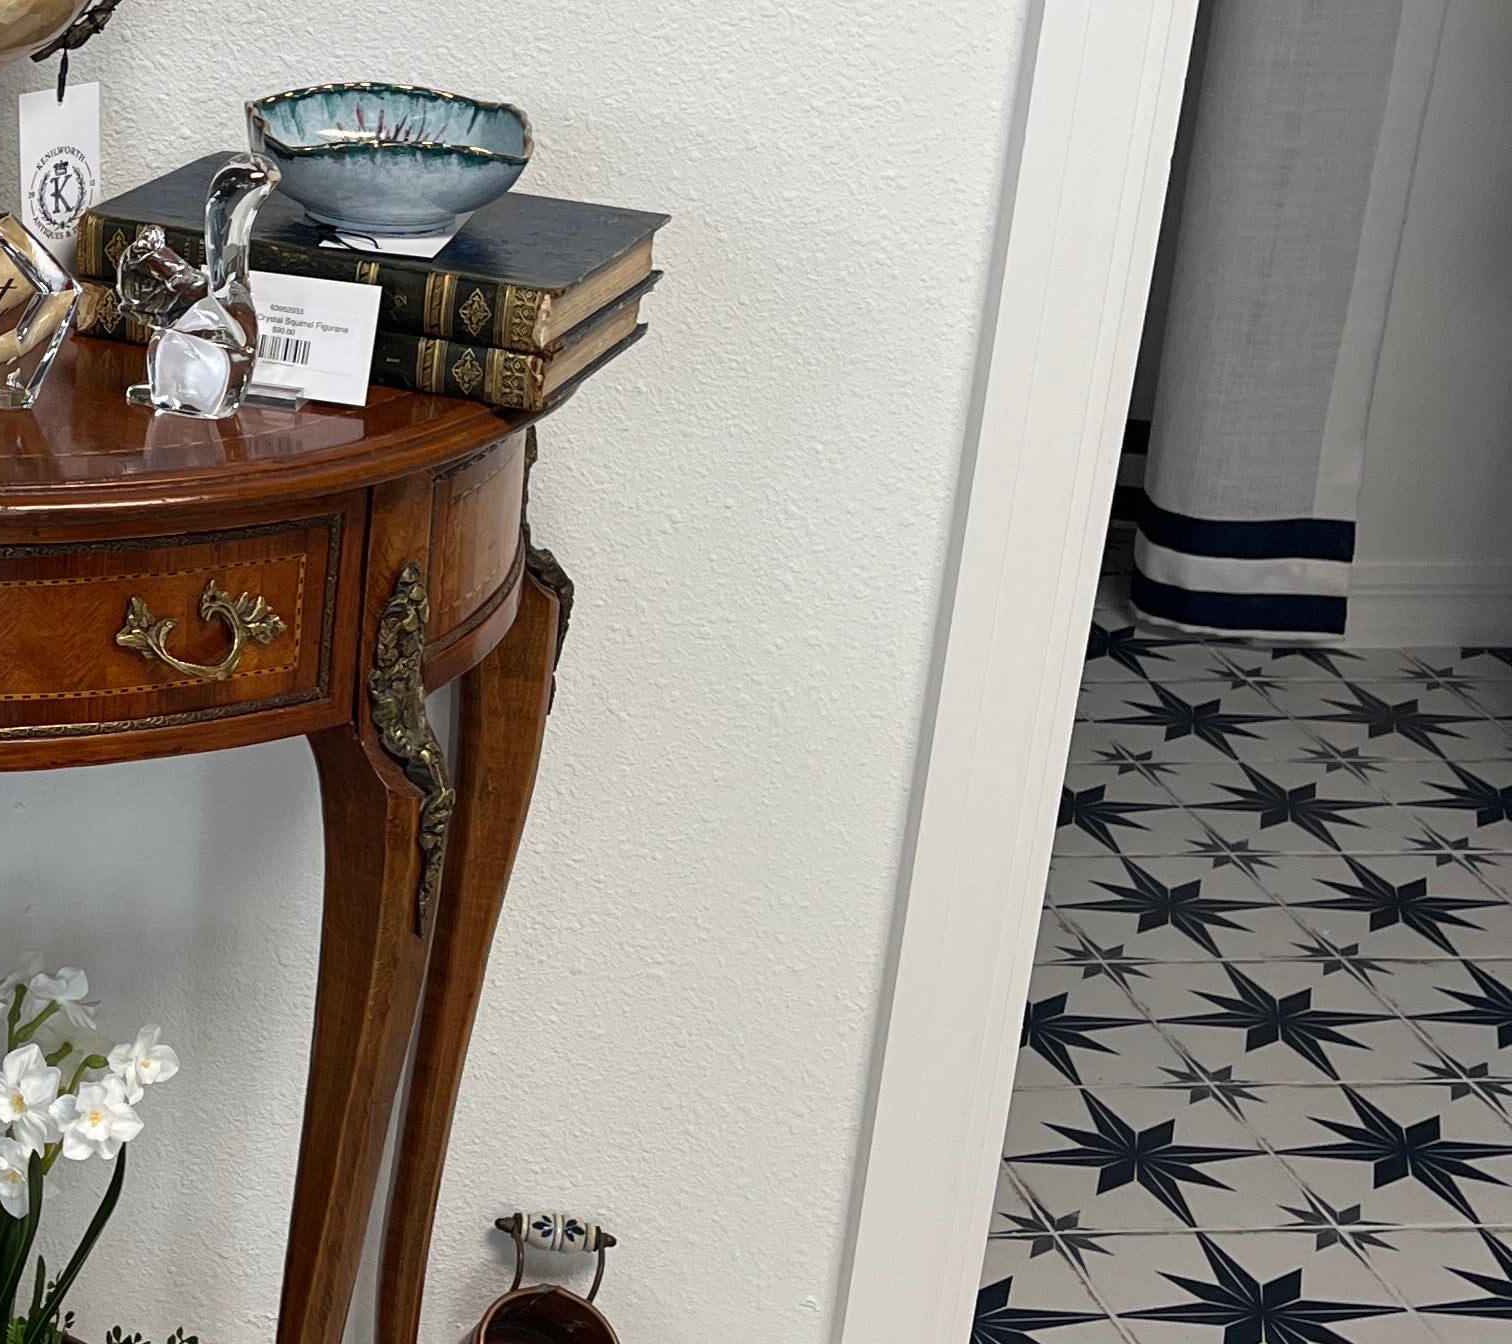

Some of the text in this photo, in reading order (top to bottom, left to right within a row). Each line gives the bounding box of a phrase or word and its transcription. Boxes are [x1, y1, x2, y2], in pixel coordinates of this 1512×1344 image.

[35, 145, 86, 171] KENILWORTH
[33, 216, 65, 240] ANTIQUES
[257, 313, 284, 324] Crystal
[284, 317, 315, 329] Squirrel
